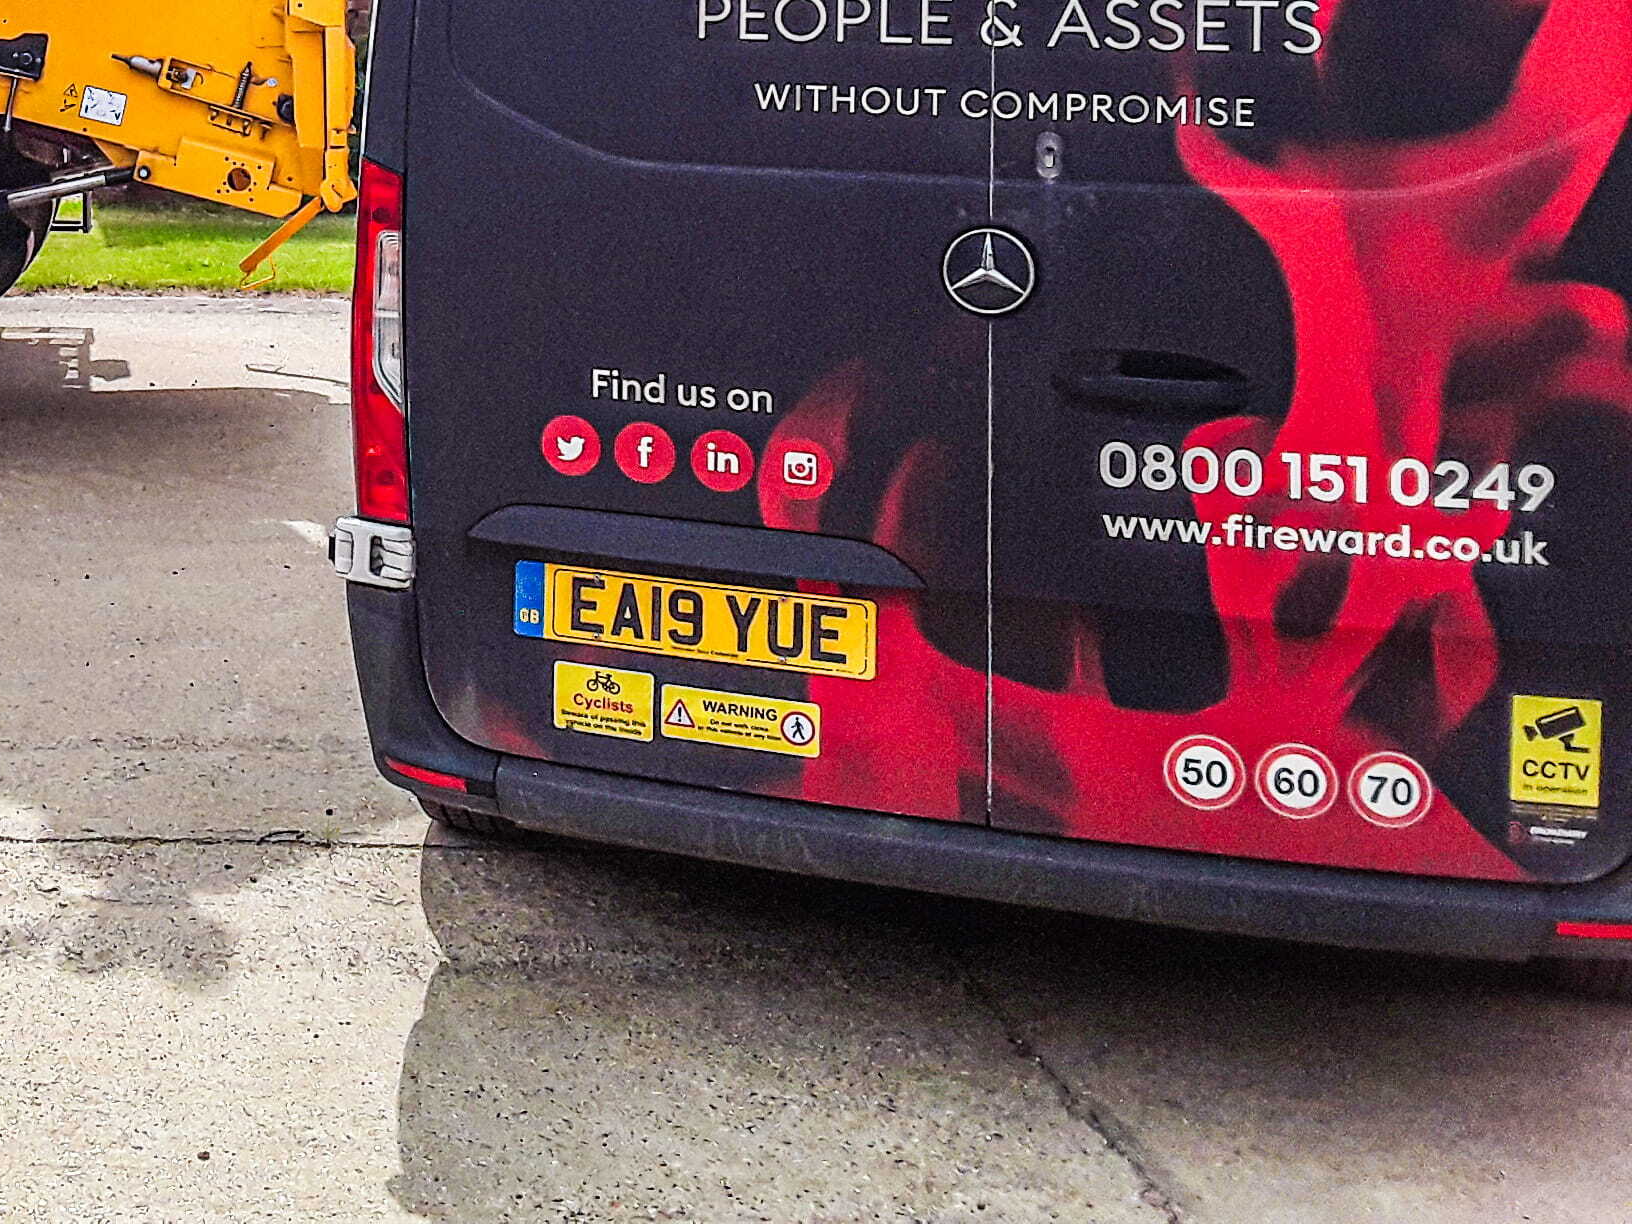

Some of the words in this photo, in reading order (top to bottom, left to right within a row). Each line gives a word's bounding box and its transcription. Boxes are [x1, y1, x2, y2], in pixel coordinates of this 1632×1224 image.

[753, 82, 947, 119] WITHOUT
[959, 88, 1256, 128] COMPROMISE
[590, 368, 666, 404] Find
[676, 382, 716, 409] us
[726, 387, 774, 414] on
[1099, 441, 1263, 497] 0800
[1280, 452, 1368, 505] 151
[1389, 457, 1555, 512] 0249
[1102, 513, 1550, 567] www.fireward.co.uk
[519, 607, 540, 625] GB
[570, 576, 703, 647] EA19
[726, 594, 848, 664] YUE
[573, 693, 634, 714] Cyclists
[702, 699, 778, 722] WARNING
[1181, 757, 1228, 789] 50
[1273, 766, 1320, 799] 60
[1522, 759, 1590, 780] CCTV
[1367, 774, 1412, 807] 70
